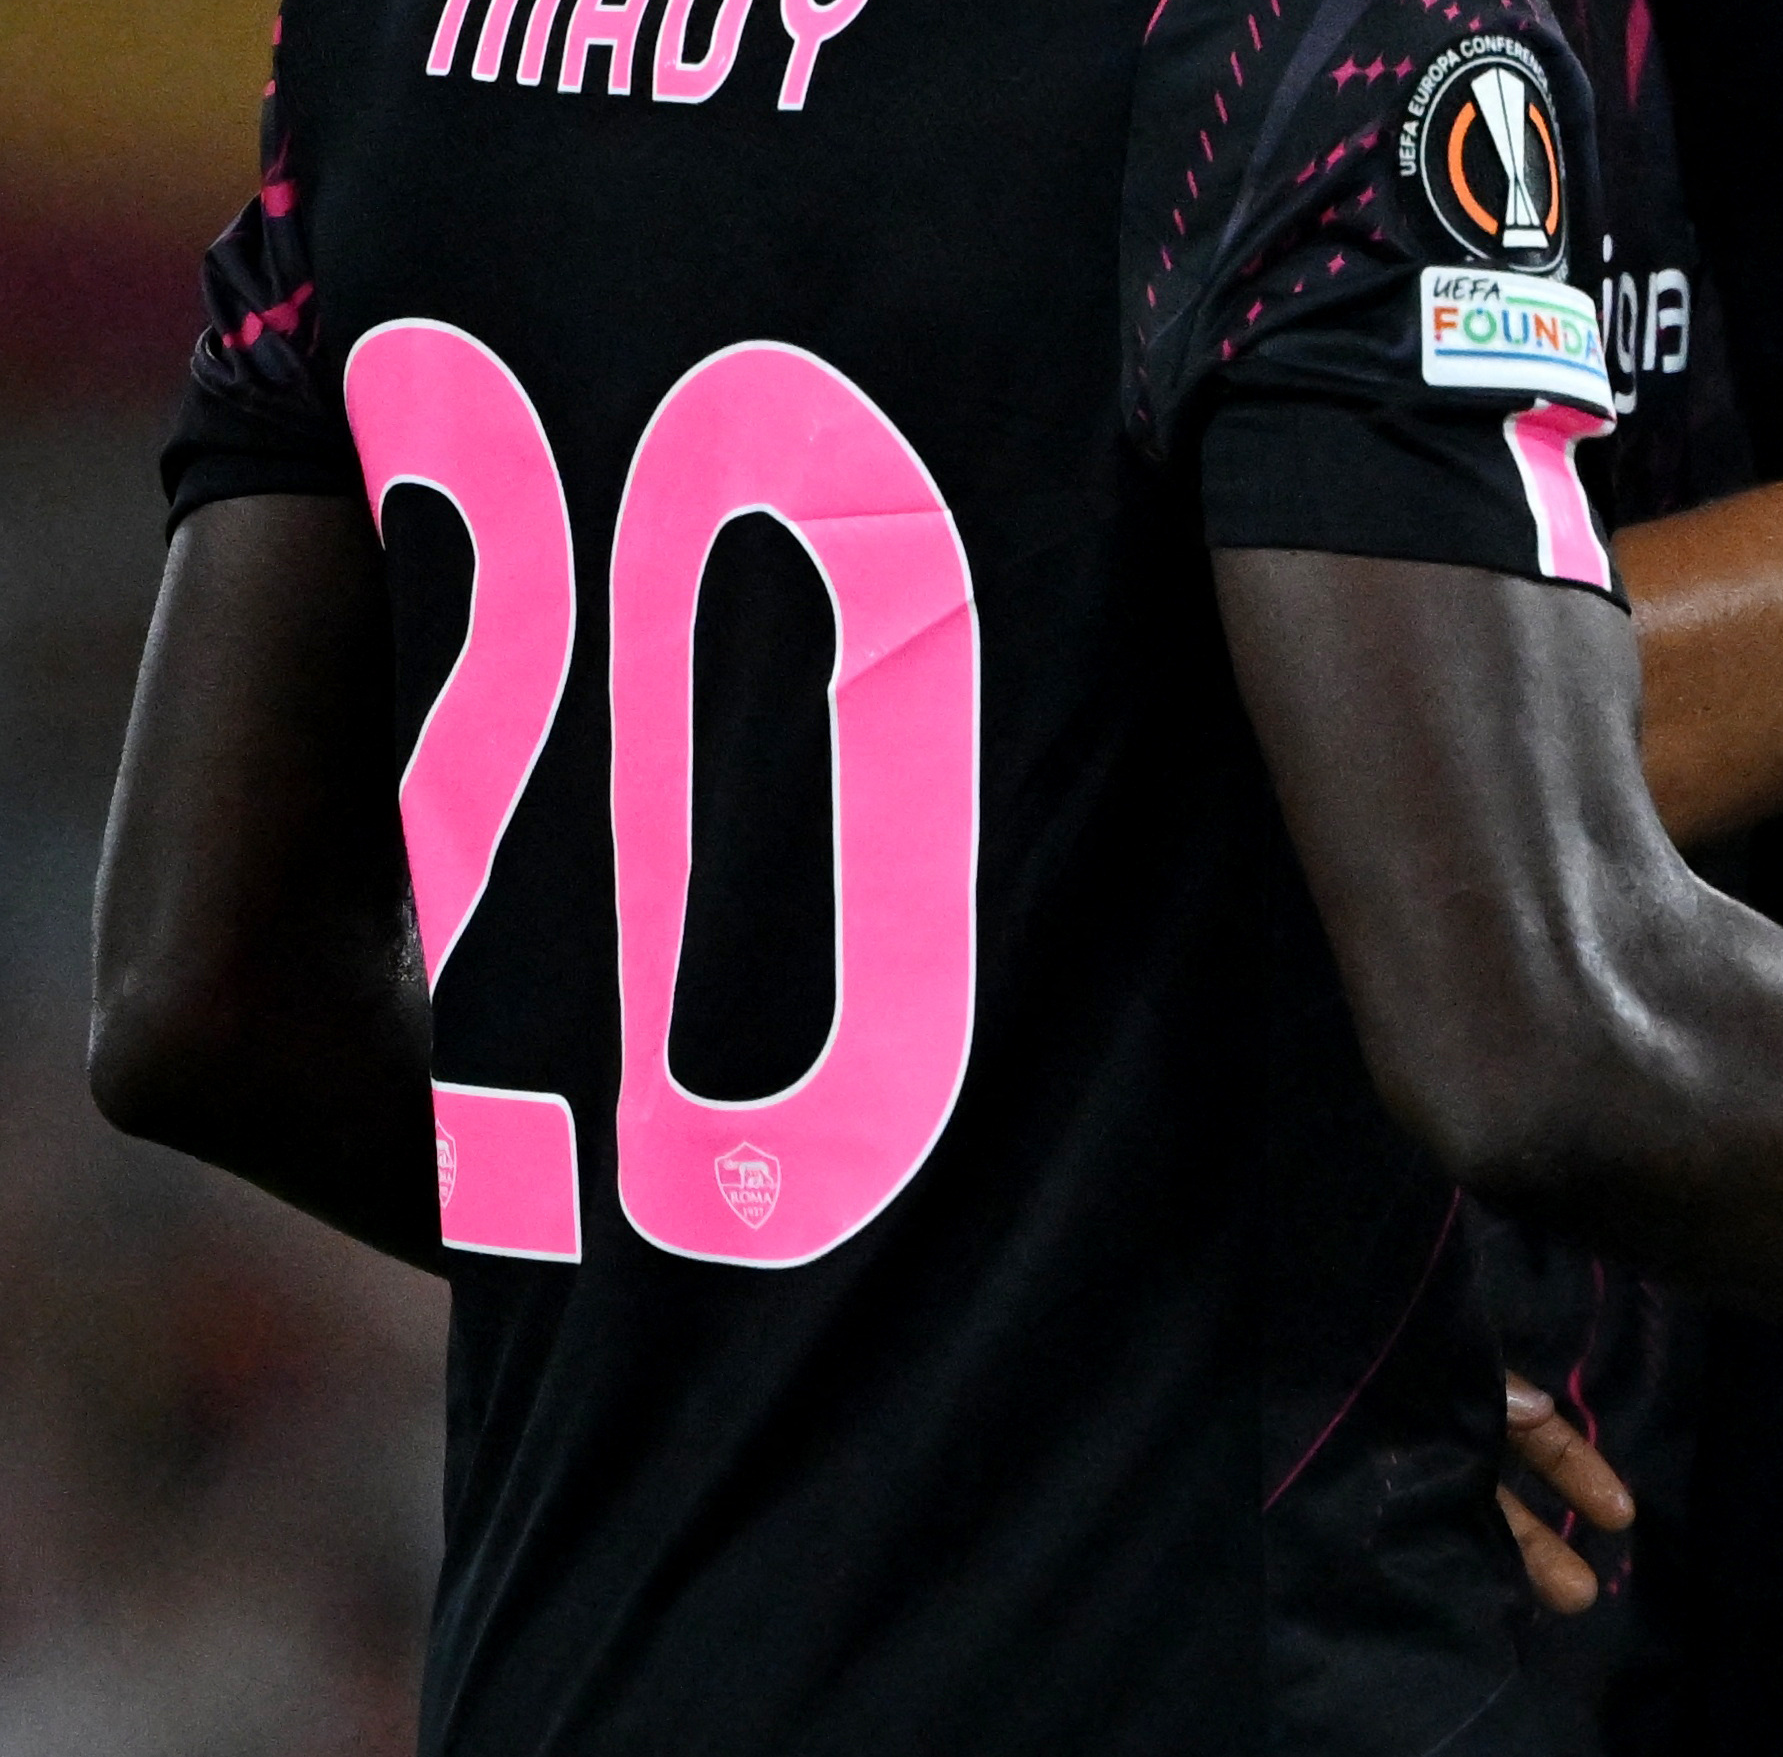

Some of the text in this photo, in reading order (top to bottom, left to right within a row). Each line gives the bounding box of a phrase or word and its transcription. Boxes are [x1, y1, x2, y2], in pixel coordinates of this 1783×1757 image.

[1408, 48, 1462, 117] EUROPA
[1399, 119, 1420, 177] UEFA
[1433, 275, 1502, 302] UEFA
[343, 317, 981, 1269] 20
[730, 1190, 776, 1205] ROMA
